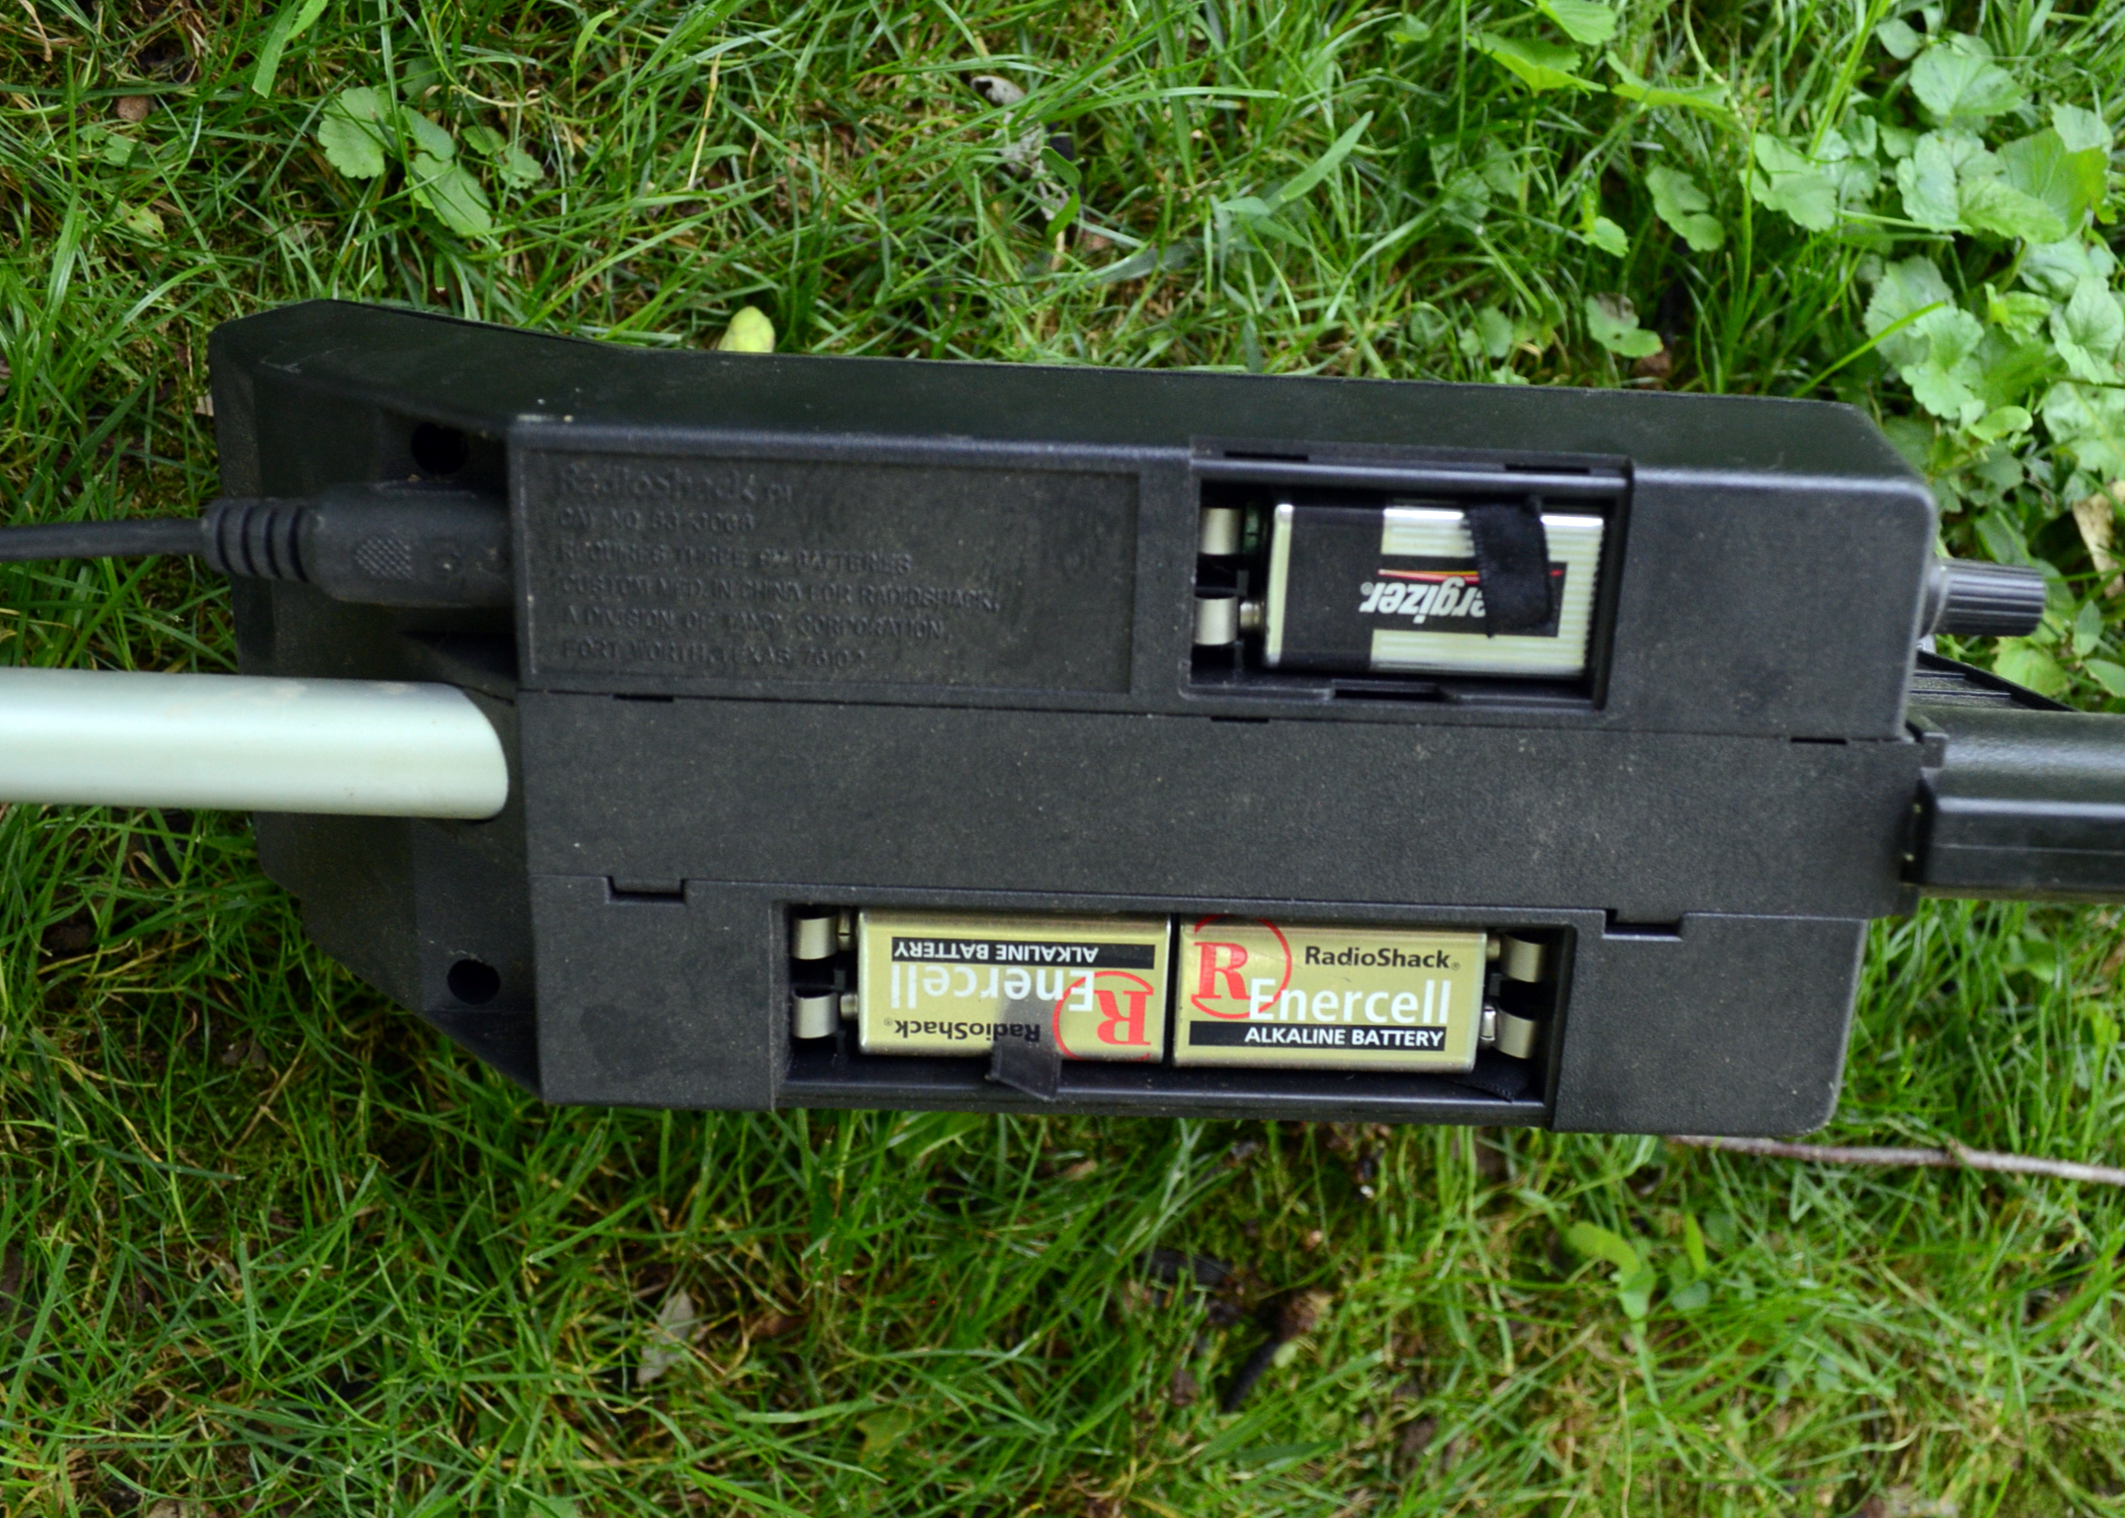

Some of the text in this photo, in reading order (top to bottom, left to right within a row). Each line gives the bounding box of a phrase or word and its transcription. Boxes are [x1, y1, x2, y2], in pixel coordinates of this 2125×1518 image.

[796, 549, 912, 575] BATTERIES
[560, 574, 650, 597] CUSTOM
[711, 577, 736, 599] IN
[740, 578, 805, 603] CHINA
[807, 581, 852, 604] FOR
[1359, 577, 1487, 625] ergizer
[564, 604, 580, 626] A
[583, 605, 675, 629] DIVISION
[685, 609, 713, 630] OF
[722, 611, 786, 635] TANDY
[562, 636, 619, 660] FORT
[893, 940, 1100, 964] ALKALINE BATTERY
[1304, 945, 1451, 970] RadioShack
[890, 964, 1095, 1013] Enercell
[1249, 977, 1452, 1025] Enercell
[894, 1019, 1041, 1043] RadioShack
[1244, 1026, 1445, 1048] ALKALINE BATTERY
